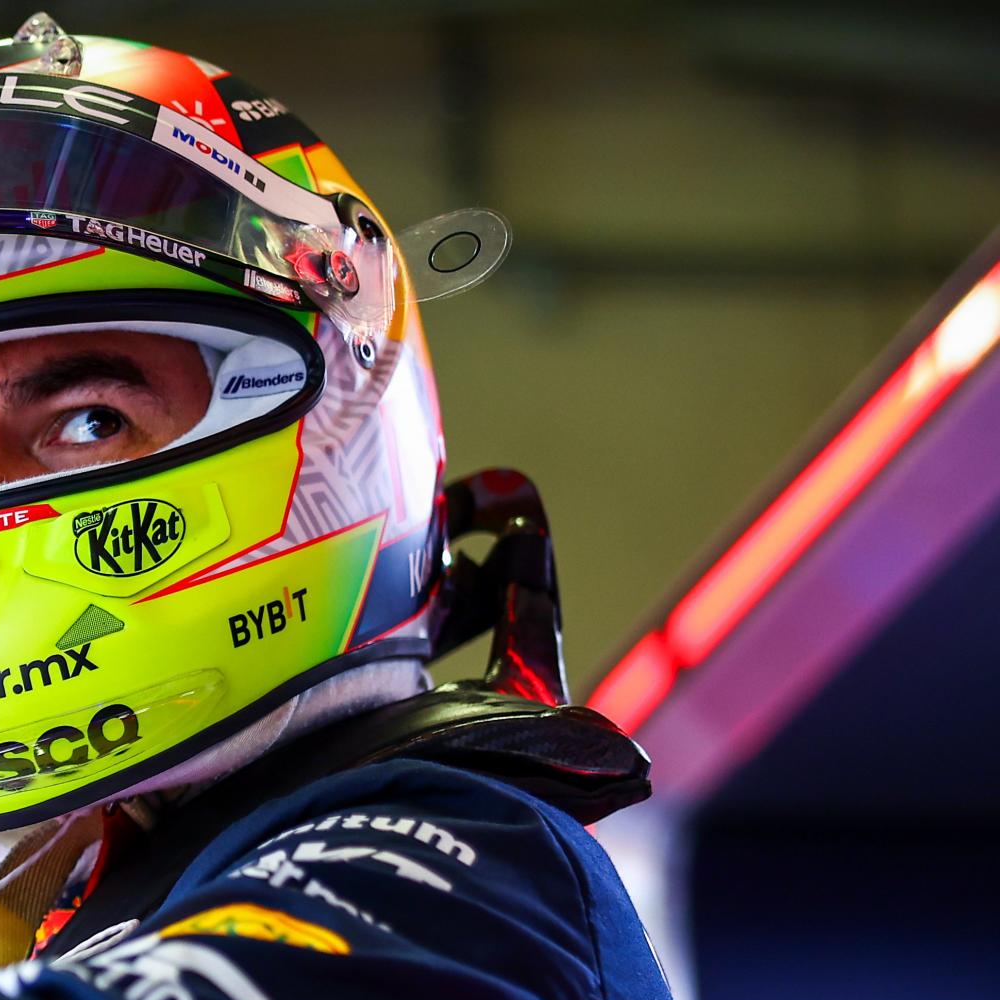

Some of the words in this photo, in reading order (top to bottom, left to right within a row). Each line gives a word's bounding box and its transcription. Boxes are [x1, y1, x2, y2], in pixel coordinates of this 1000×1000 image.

[172, 126, 241, 175] Mobil
[241, 372, 304, 389] Blenders
[88, 502, 180, 574] KitKat
[228, 586, 308, 649] BYBIT
